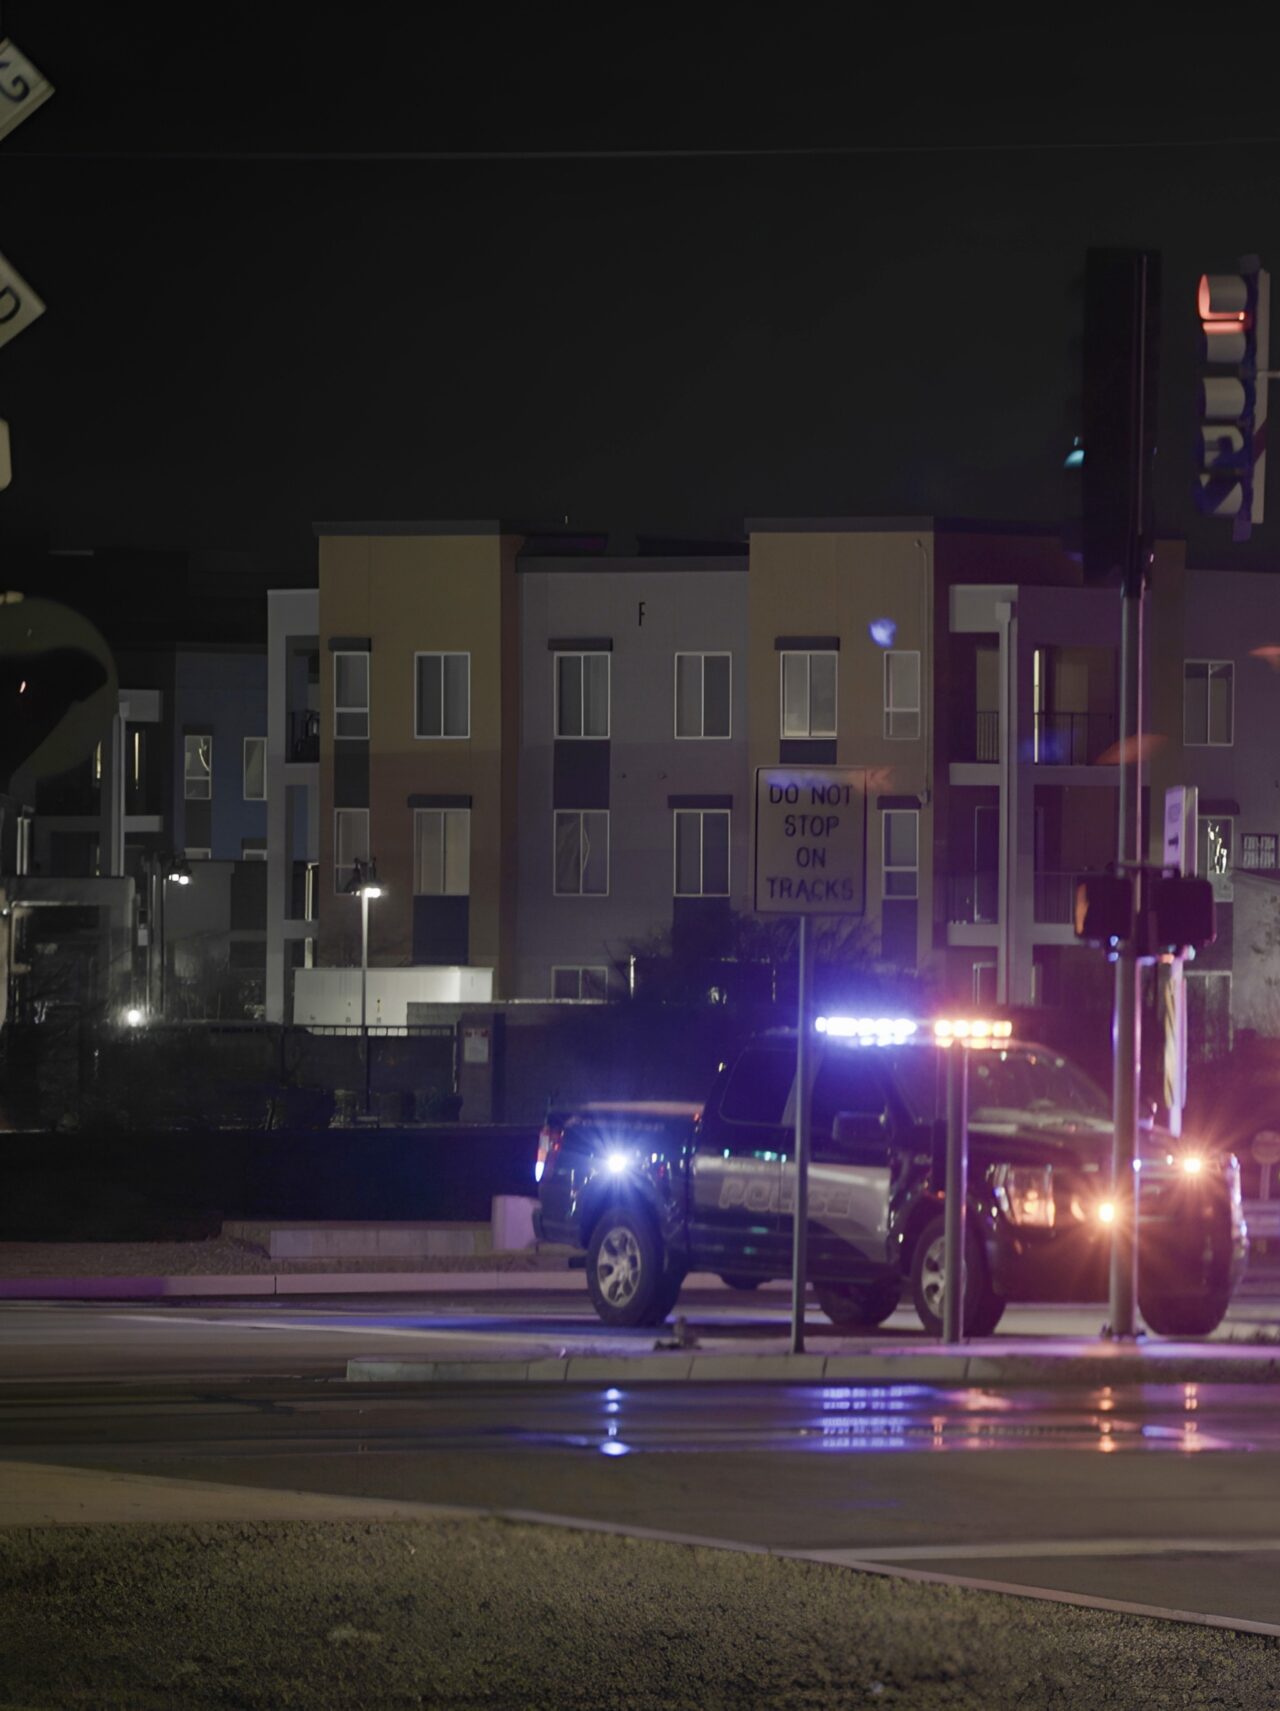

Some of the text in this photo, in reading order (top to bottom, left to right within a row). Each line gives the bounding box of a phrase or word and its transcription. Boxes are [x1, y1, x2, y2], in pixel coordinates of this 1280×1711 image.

[769, 783, 853, 806] DO NOT
[784, 814, 840, 838] STOP
[796, 846, 827, 869] ON
[766, 876, 854, 902] TRACKS
[718, 1176, 852, 1217] POLCE
